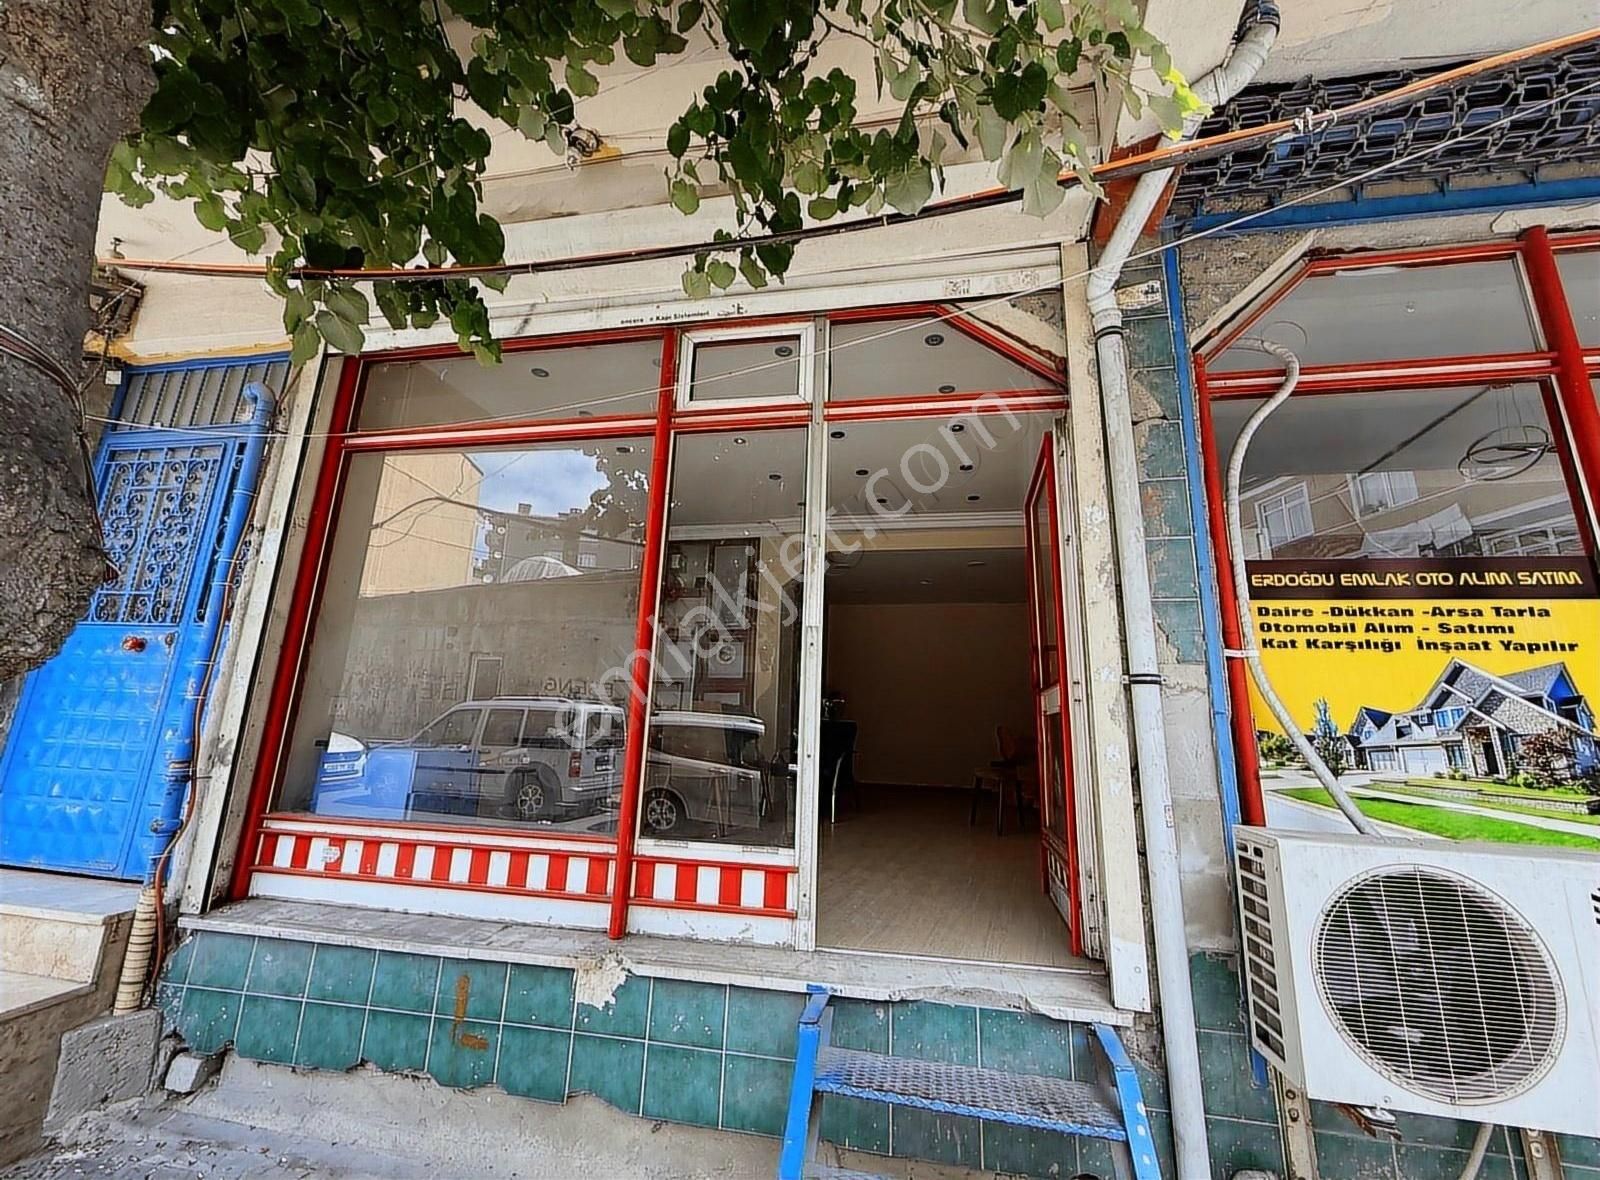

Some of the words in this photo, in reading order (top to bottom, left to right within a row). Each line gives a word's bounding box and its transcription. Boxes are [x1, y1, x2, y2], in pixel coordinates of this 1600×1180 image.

[1251, 571, 1335, 587] ERDOĞDU
[1340, 573, 1412, 587] EMLAK
[1415, 572, 1454, 586] OTO
[1459, 572, 1514, 586] ALIM
[1517, 571, 1584, 585] SATIM
[1257, 606, 1314, 617] Daire
[1491, 606, 1551, 617] Tarla
[1259, 622, 1357, 633] Otomobil
[1364, 622, 1414, 633] Alım
[1438, 622, 1516, 634] Satımı
[1261, 638, 1299, 649] Kat
[1305, 637, 1402, 653] Karşılığı
[1417, 636, 1493, 653] İnşaat
[1499, 639, 1579, 654] Yapılır
